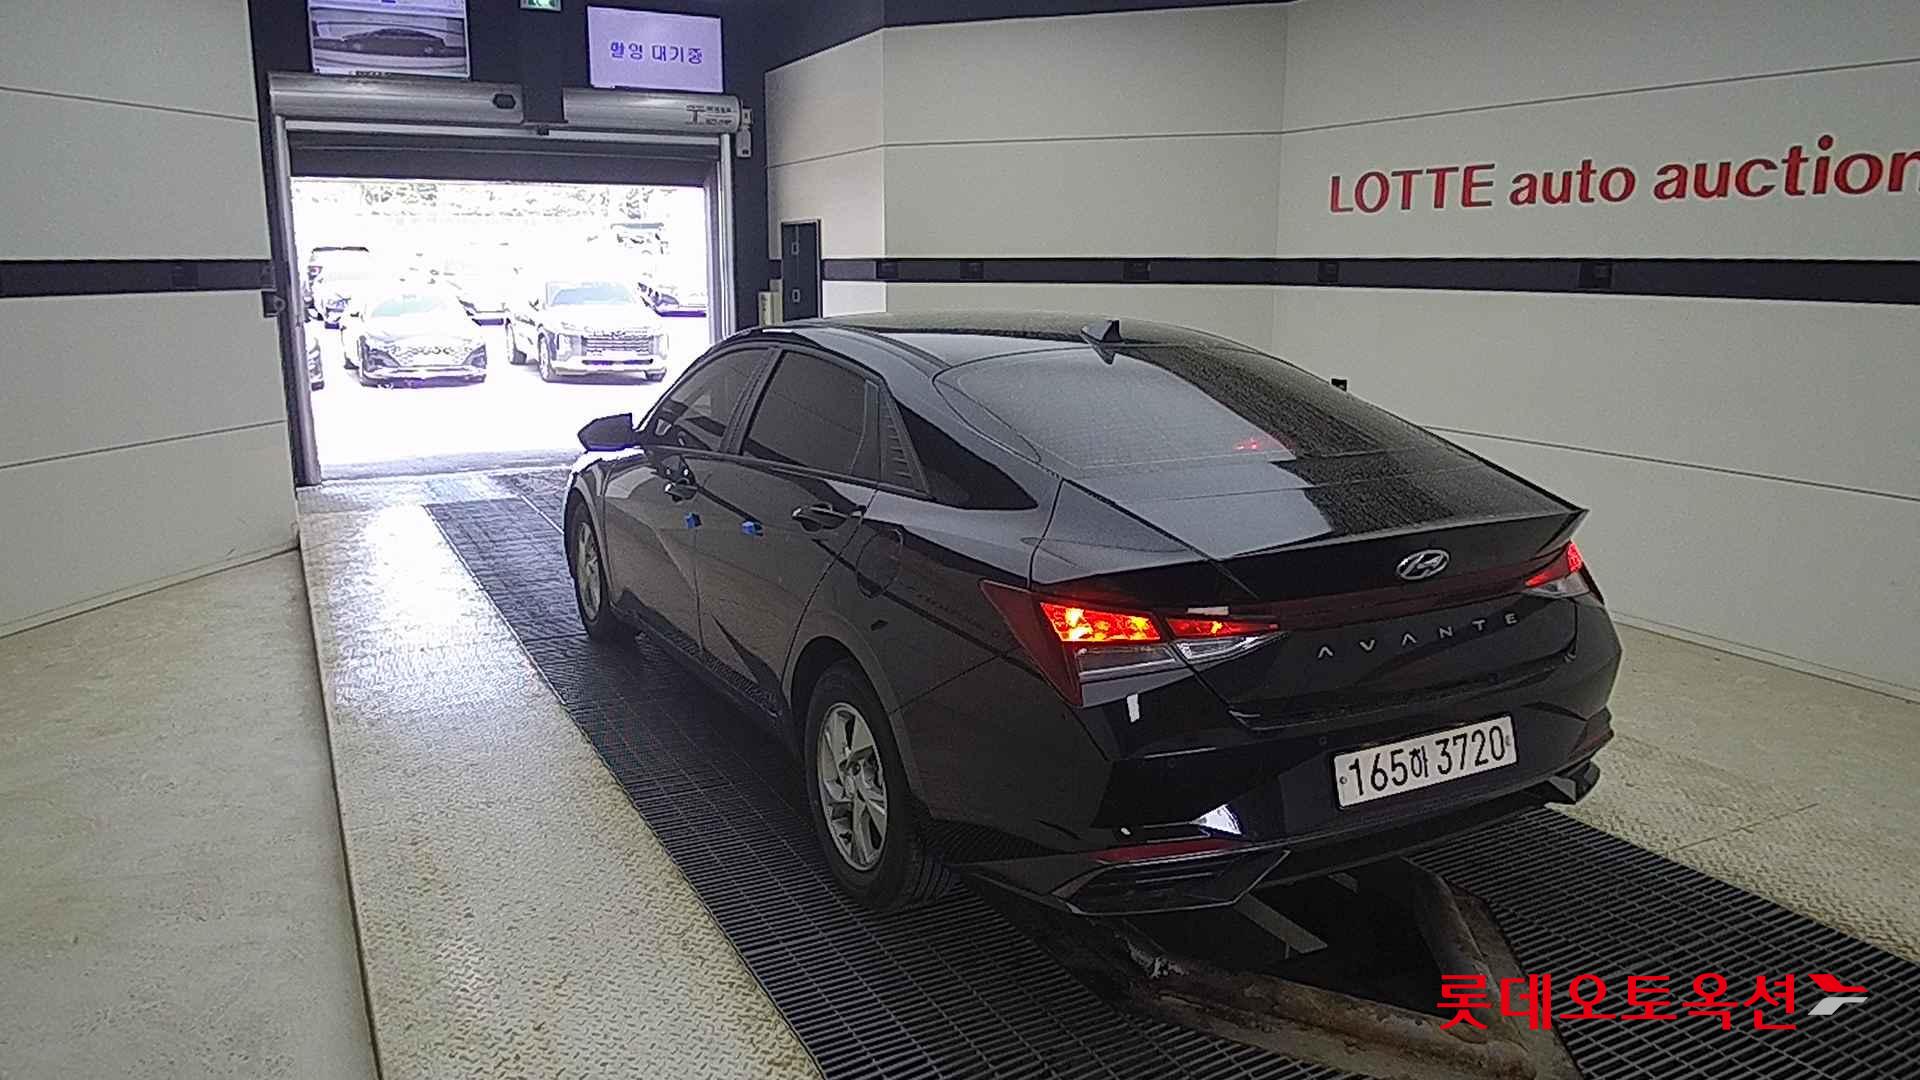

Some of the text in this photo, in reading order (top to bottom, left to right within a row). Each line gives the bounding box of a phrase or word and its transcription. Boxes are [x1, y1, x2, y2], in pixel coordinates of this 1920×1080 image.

[1330, 163, 1496, 213] LOTTE
[1510, 159, 1636, 206] auto
[1317, 612, 1519, 659] AVANTE
[1348, 725, 1506, 798] 165하 3720
